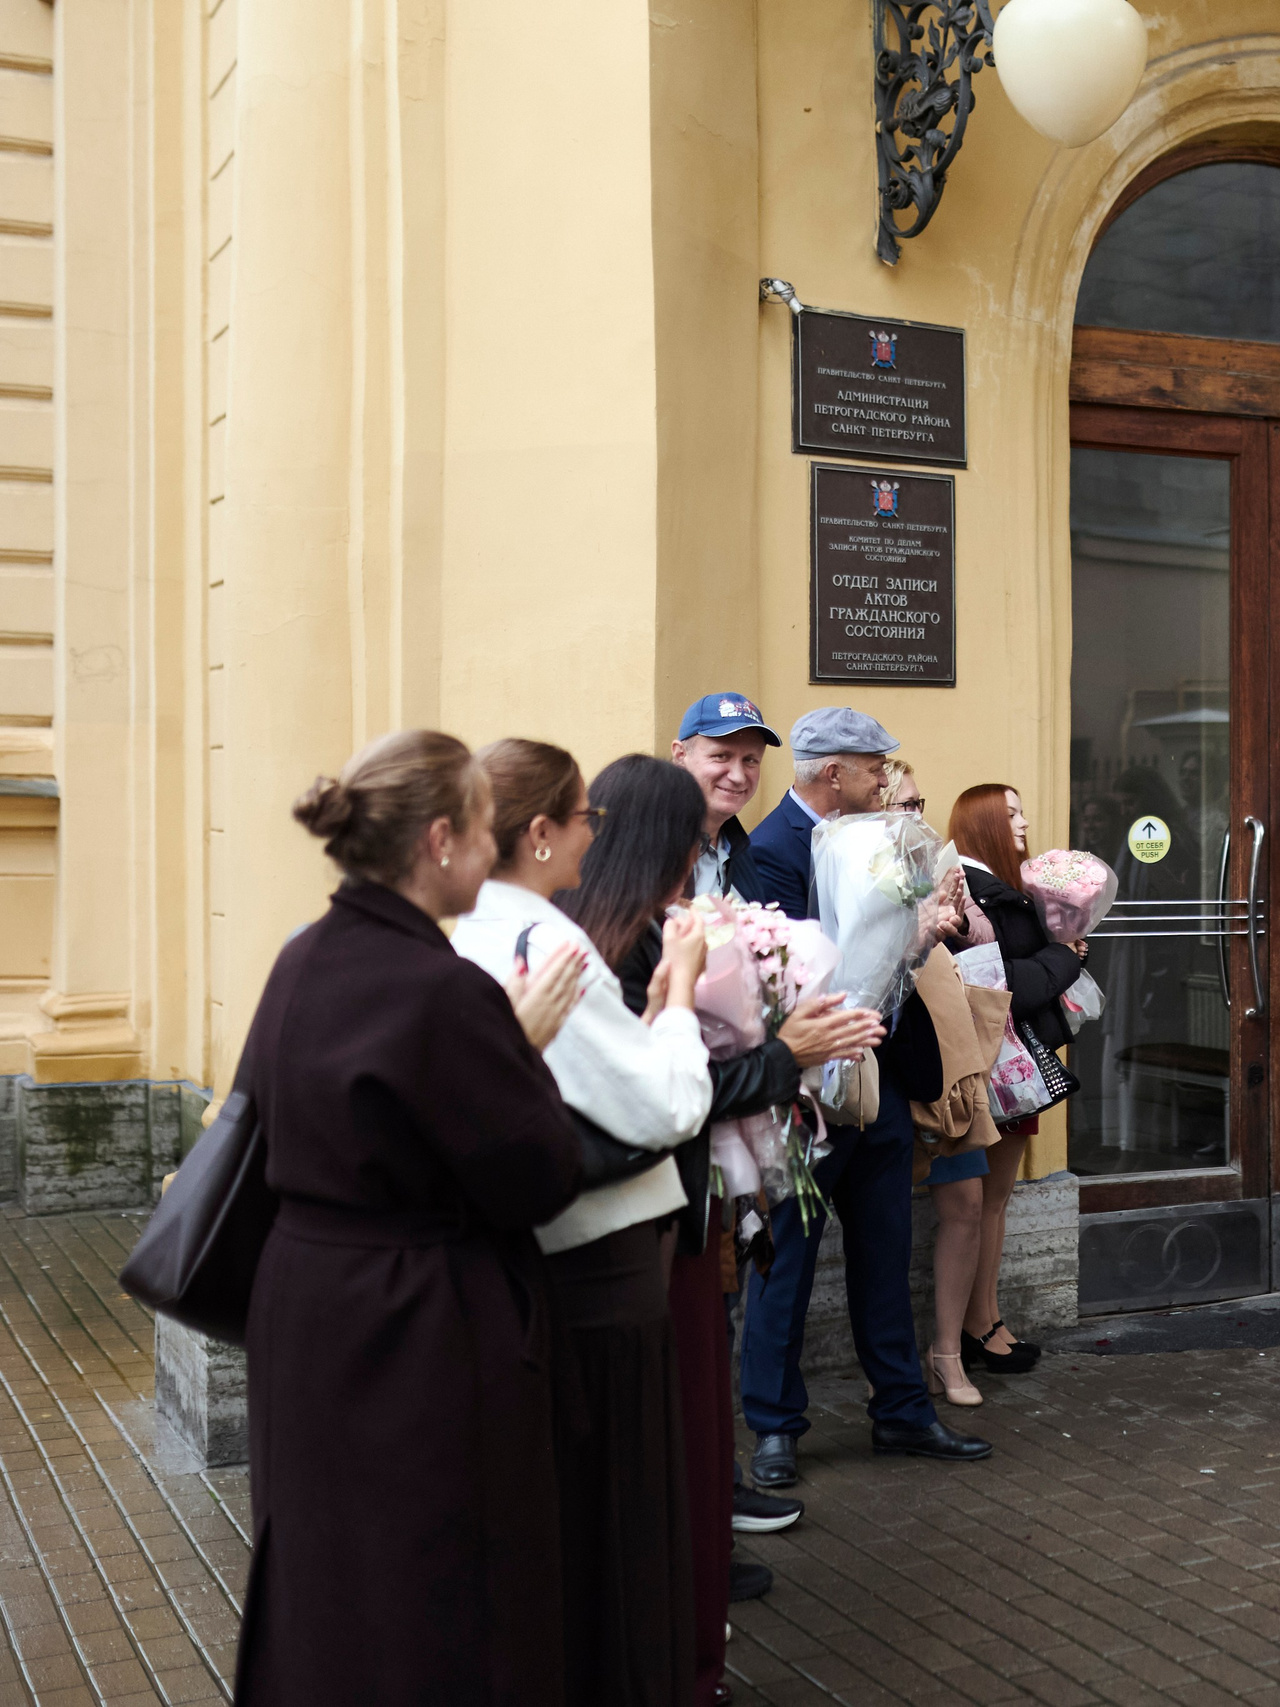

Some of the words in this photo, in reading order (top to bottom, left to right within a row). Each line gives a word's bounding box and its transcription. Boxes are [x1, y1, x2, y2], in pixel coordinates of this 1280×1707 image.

[817, 367, 876, 381] ПРАВИТЕЛЬСТВО
[837, 390, 929, 410] АДМИНИСТРАЦИЯ
[814, 404, 907, 423] ПЕТРОГРАДСКОГО
[912, 414, 951, 428] РАЙОНА
[820, 516, 878, 528] ПРАВИТЕЛЬСТВО
[848, 536, 881, 544] КОМИТЕТ
[898, 540, 922, 548] ДЕЛАМ
[828, 543, 858, 552] ЗАПИСИ
[860, 545, 884, 554] АКТОВ
[885, 546, 941, 558] ГРАЖДАНСКОГО
[865, 554, 907, 564] СОСТОЯНИЯ
[832, 574, 878, 590] ОТДЕЛ
[886, 578, 938, 592] ЗАПИСИ
[864, 593, 908, 606] АКТОВ
[829, 607, 941, 625] ГРАЖДАНСКОГО
[845, 624, 926, 640] СОСТОЯНИЯ
[832, 652, 904, 663] ПЕТРОГРАДСКОГО
[908, 653, 938, 664] РАЙОНА
[846, 662, 924, 673] САНКТ-ПЕТЕРБУРГА
